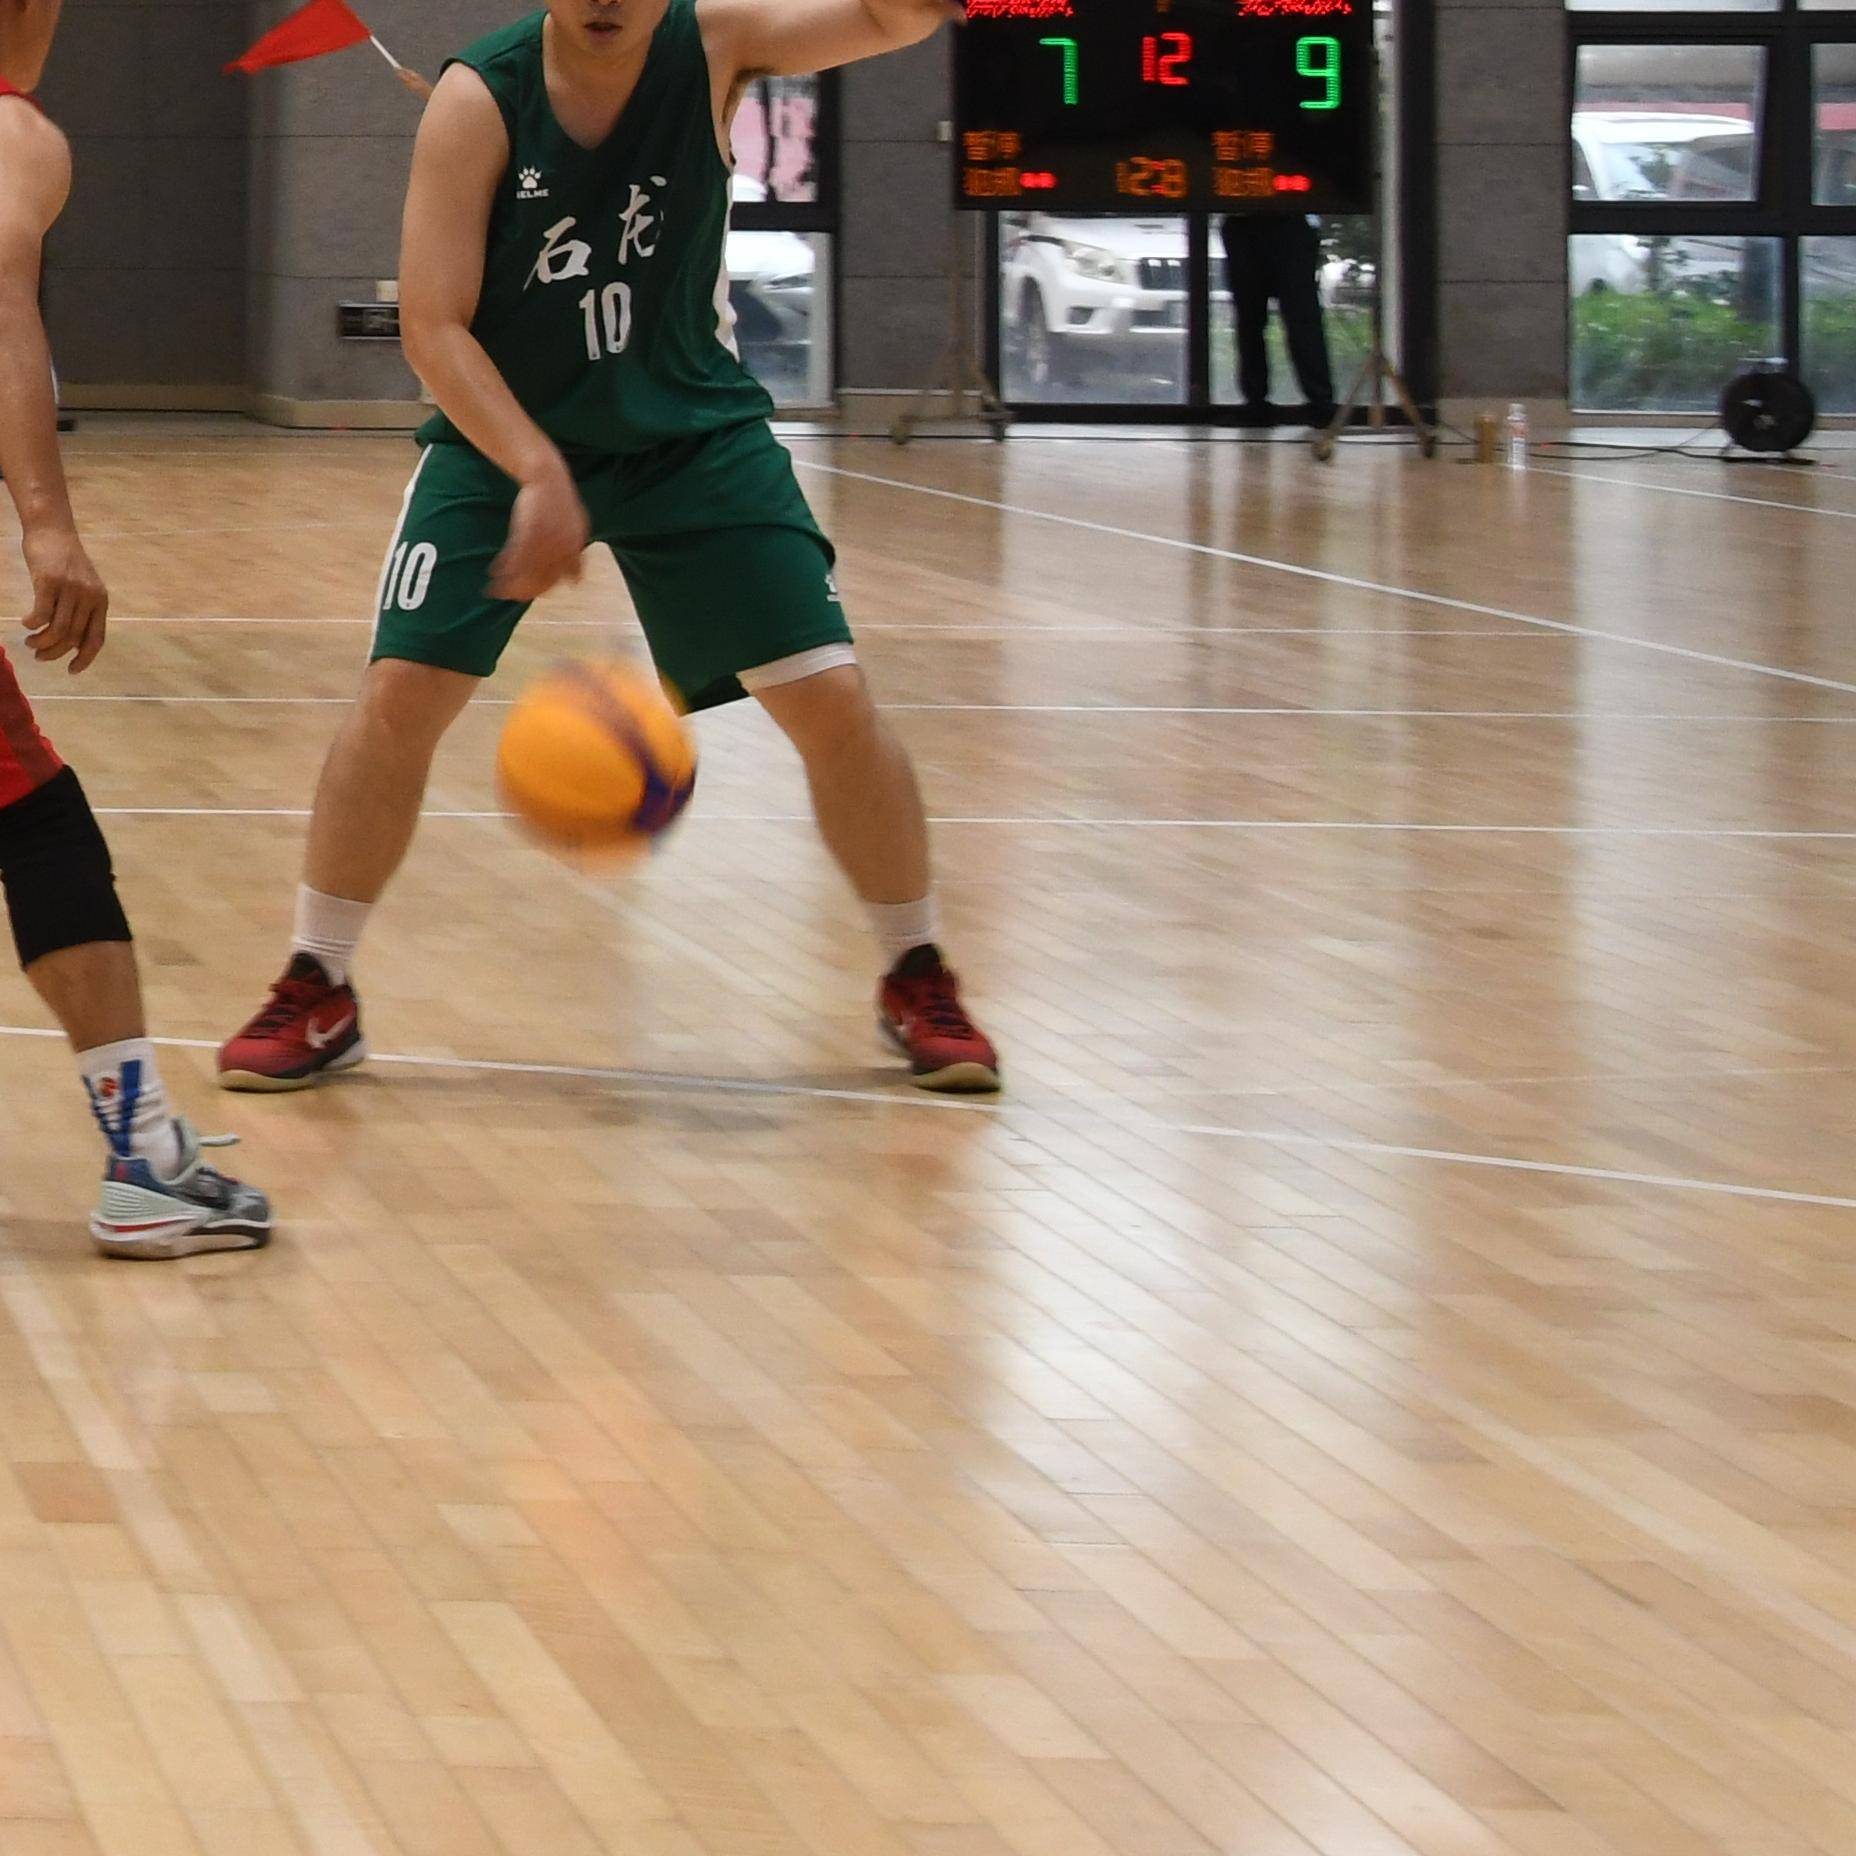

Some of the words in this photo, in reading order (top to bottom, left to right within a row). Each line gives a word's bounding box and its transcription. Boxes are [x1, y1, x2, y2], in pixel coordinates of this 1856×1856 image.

[1039, 37, 1078, 105] 7
[1141, 32, 1191, 86] 12
[1296, 37, 1341, 110] 9
[577, 280, 633, 361] 10
[381, 539, 438, 612] 10
